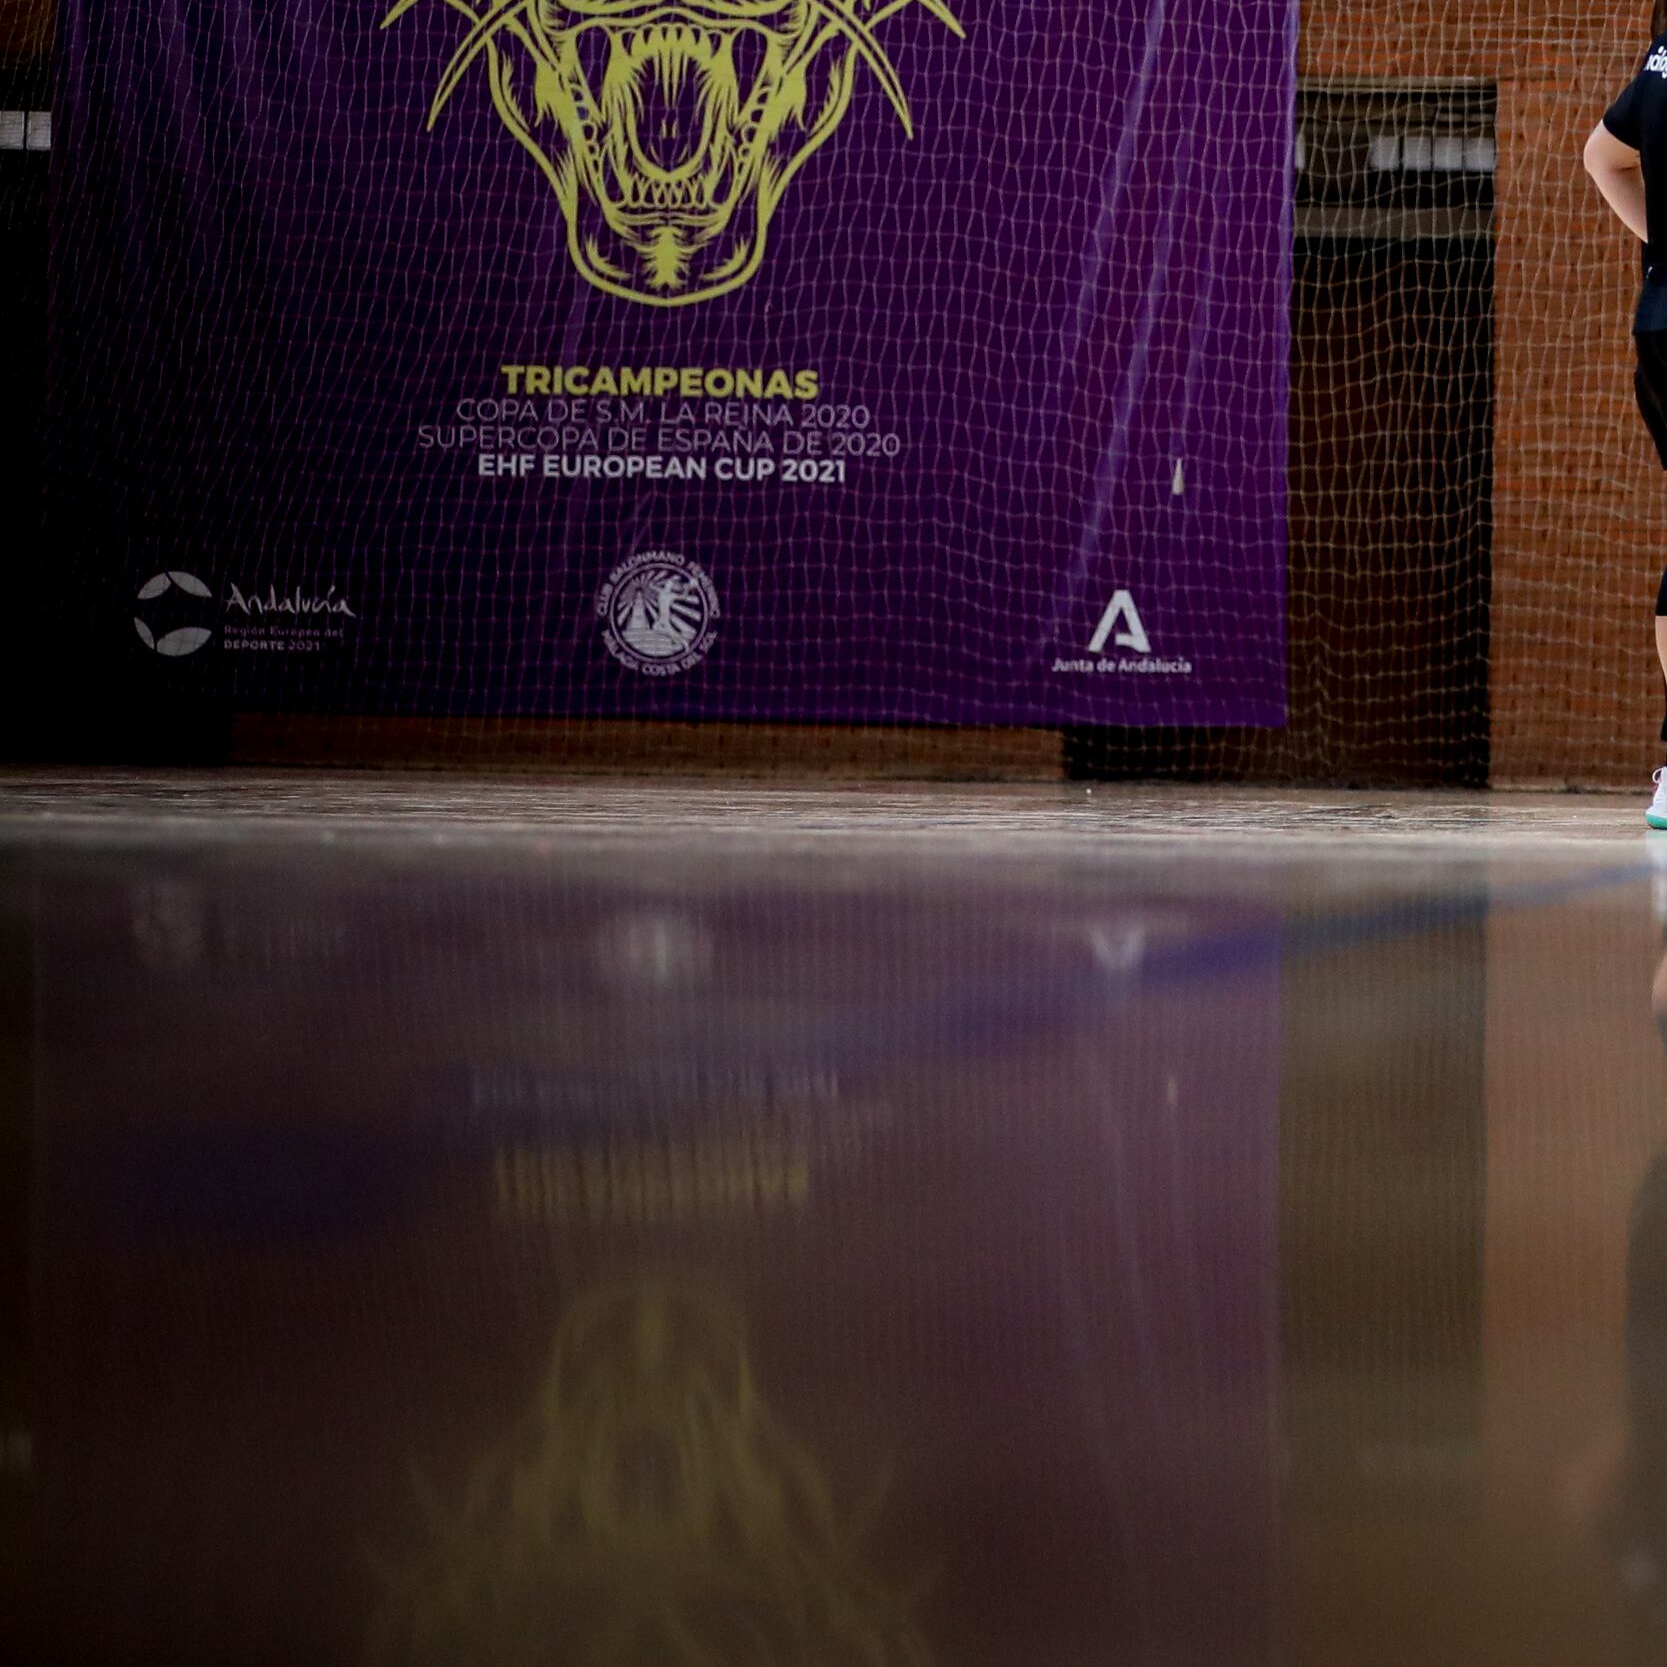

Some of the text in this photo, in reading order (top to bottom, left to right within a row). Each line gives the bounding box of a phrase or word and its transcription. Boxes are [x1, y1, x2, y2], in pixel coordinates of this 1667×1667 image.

[501, 365, 819, 399] TRICAMPEONAS
[457, 398, 871, 429] COPA DE S.M. LA REINA 2020
[418, 421, 901, 457] SUPERCOPA DE ESPAÑA DE 2020
[478, 454, 846, 483] EHF EUROPEAN CUP 2021
[225, 582, 357, 618] Andalucía
[224, 639, 320, 651] DEPORTE 2021
[1052, 657, 1192, 673] Junta de Andalucía
